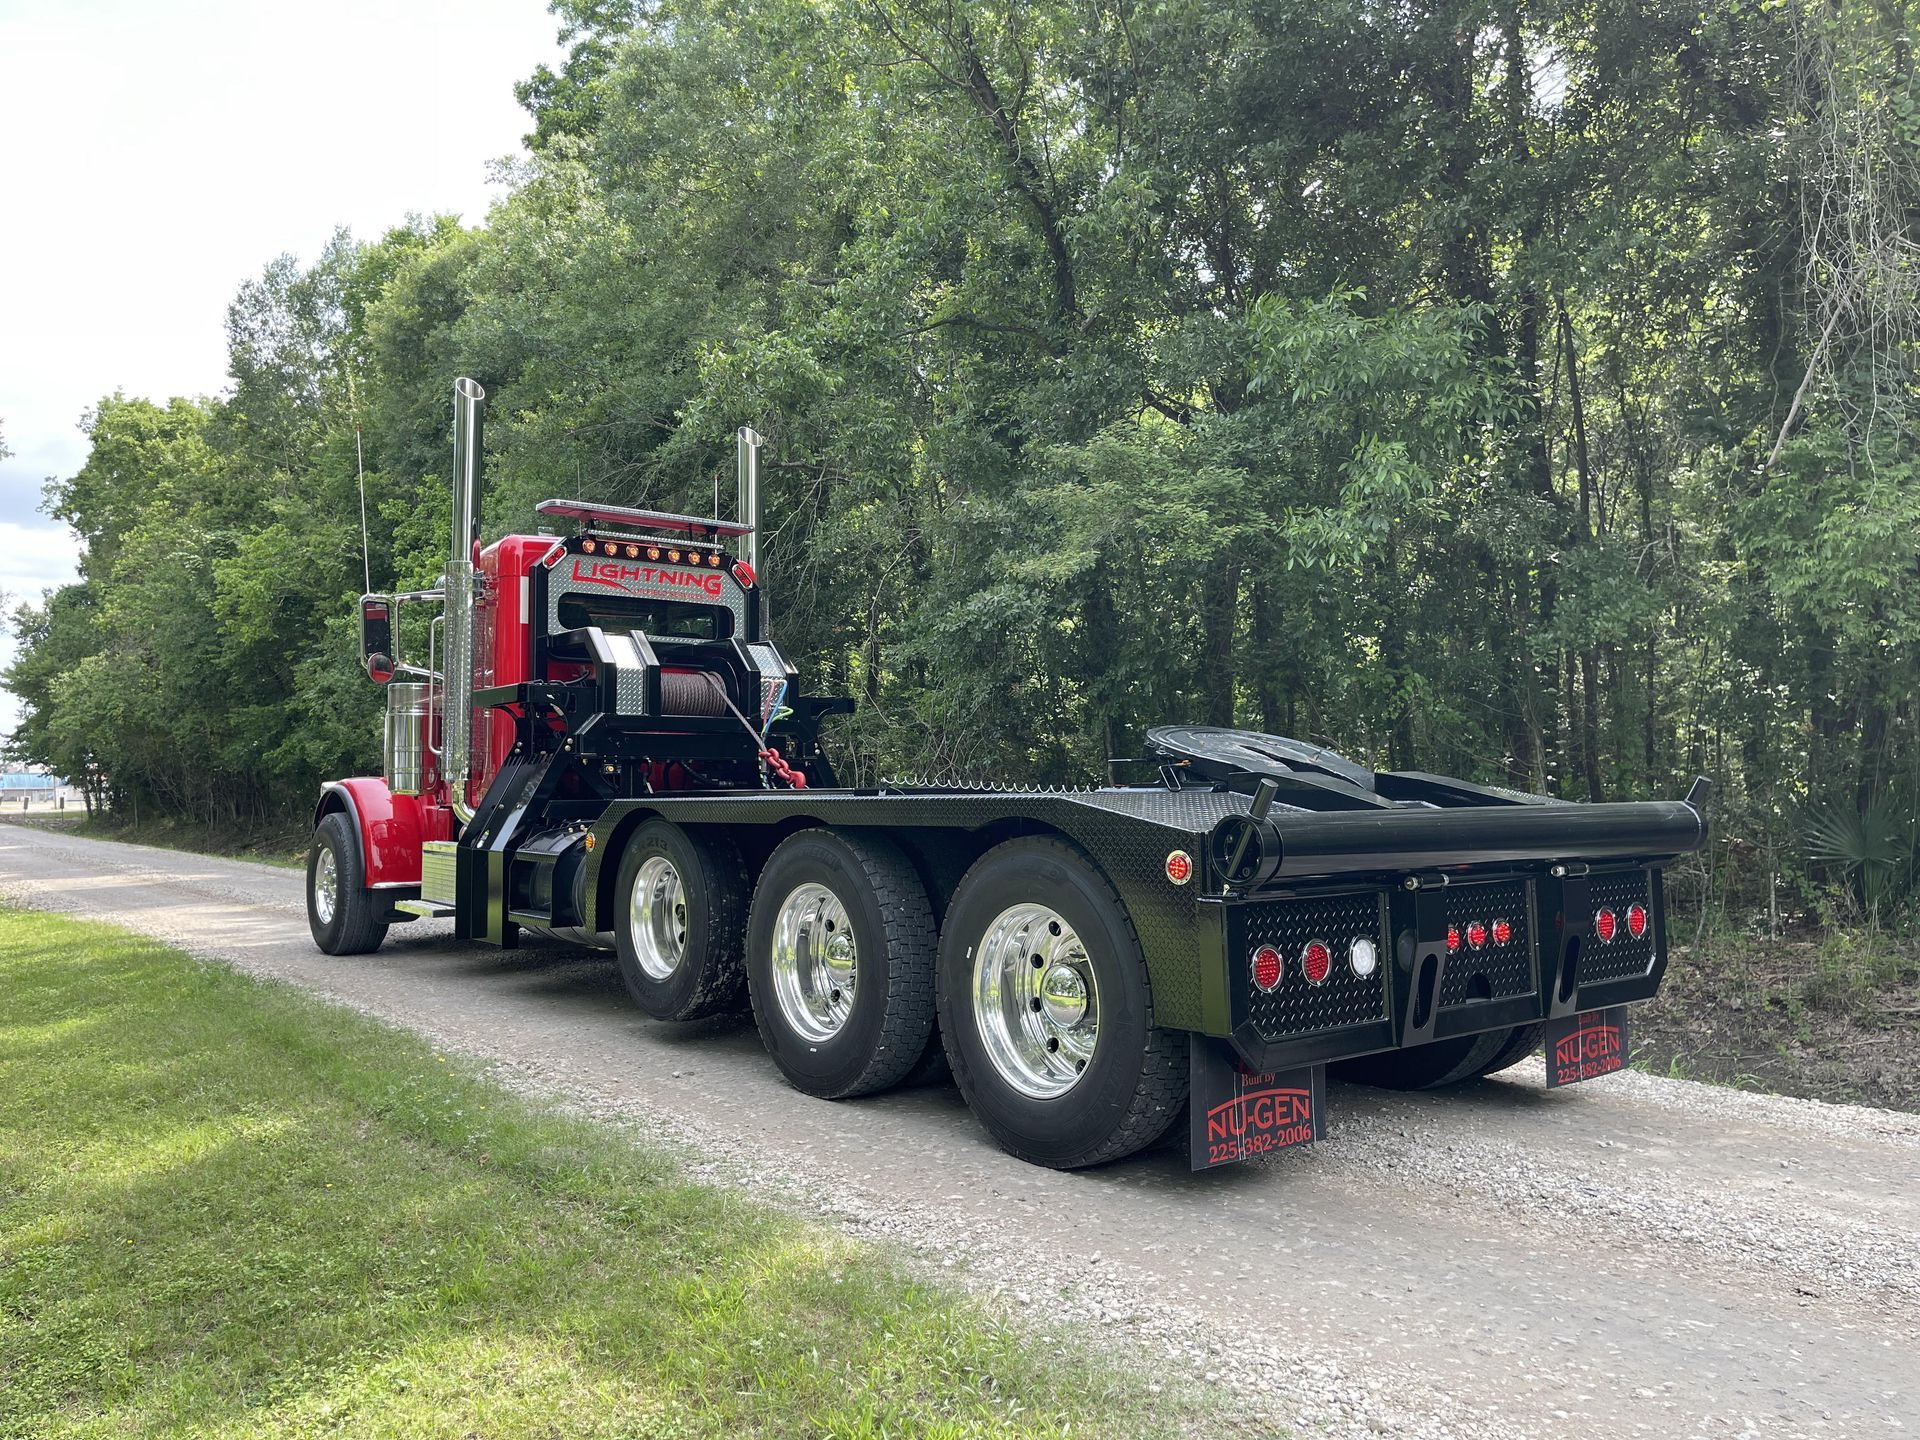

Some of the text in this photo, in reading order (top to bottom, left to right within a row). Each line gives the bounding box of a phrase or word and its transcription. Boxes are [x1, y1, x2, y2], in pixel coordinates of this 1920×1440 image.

[572, 560, 722, 595] LIGHTNING
[1556, 1033, 1620, 1066] NU-GEN
[1557, 1056, 1621, 1083] 225-382-2006
[1208, 1097, 1310, 1142] NU-GEN
[1209, 1124, 1312, 1163] 225-382-2006
